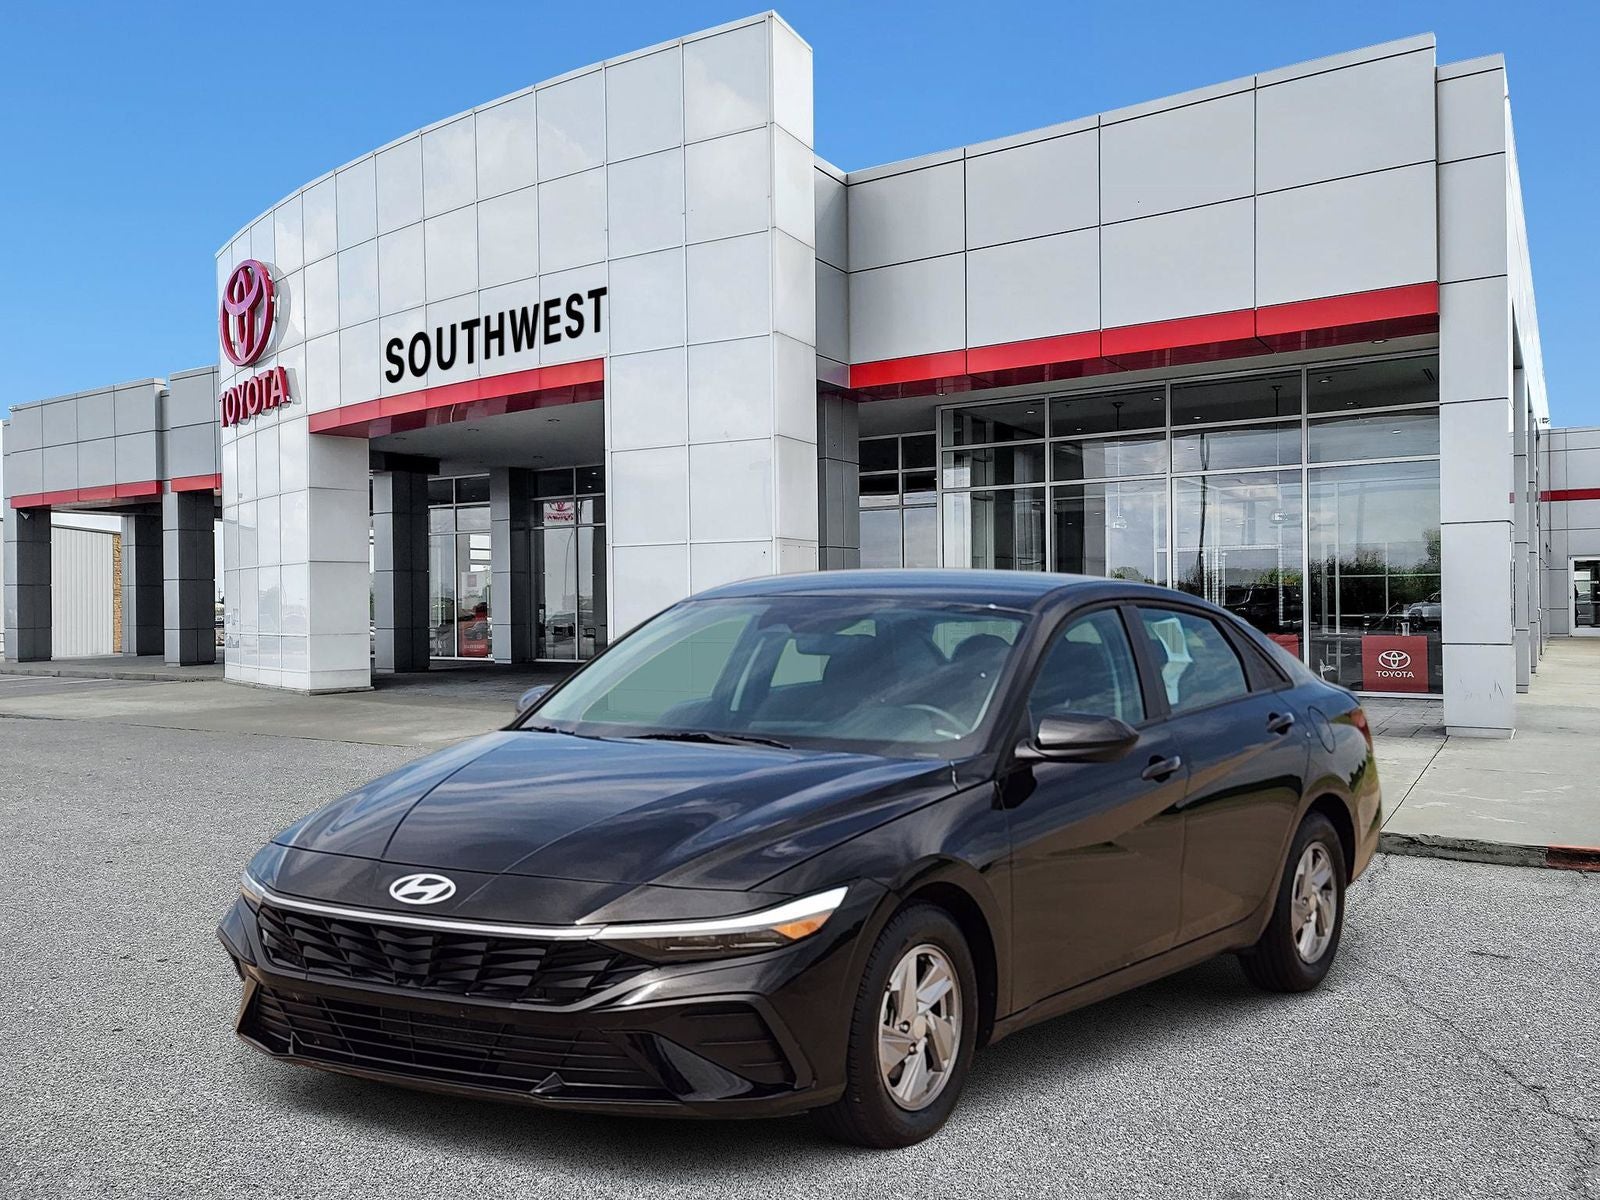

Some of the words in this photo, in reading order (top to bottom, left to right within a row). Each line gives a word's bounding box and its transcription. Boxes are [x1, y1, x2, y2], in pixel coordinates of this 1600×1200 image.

[385, 286, 608, 384] SOUTHWEST
[219, 366, 291, 428] TOYOTA
[1376, 670, 1415, 678] TOYOTA
